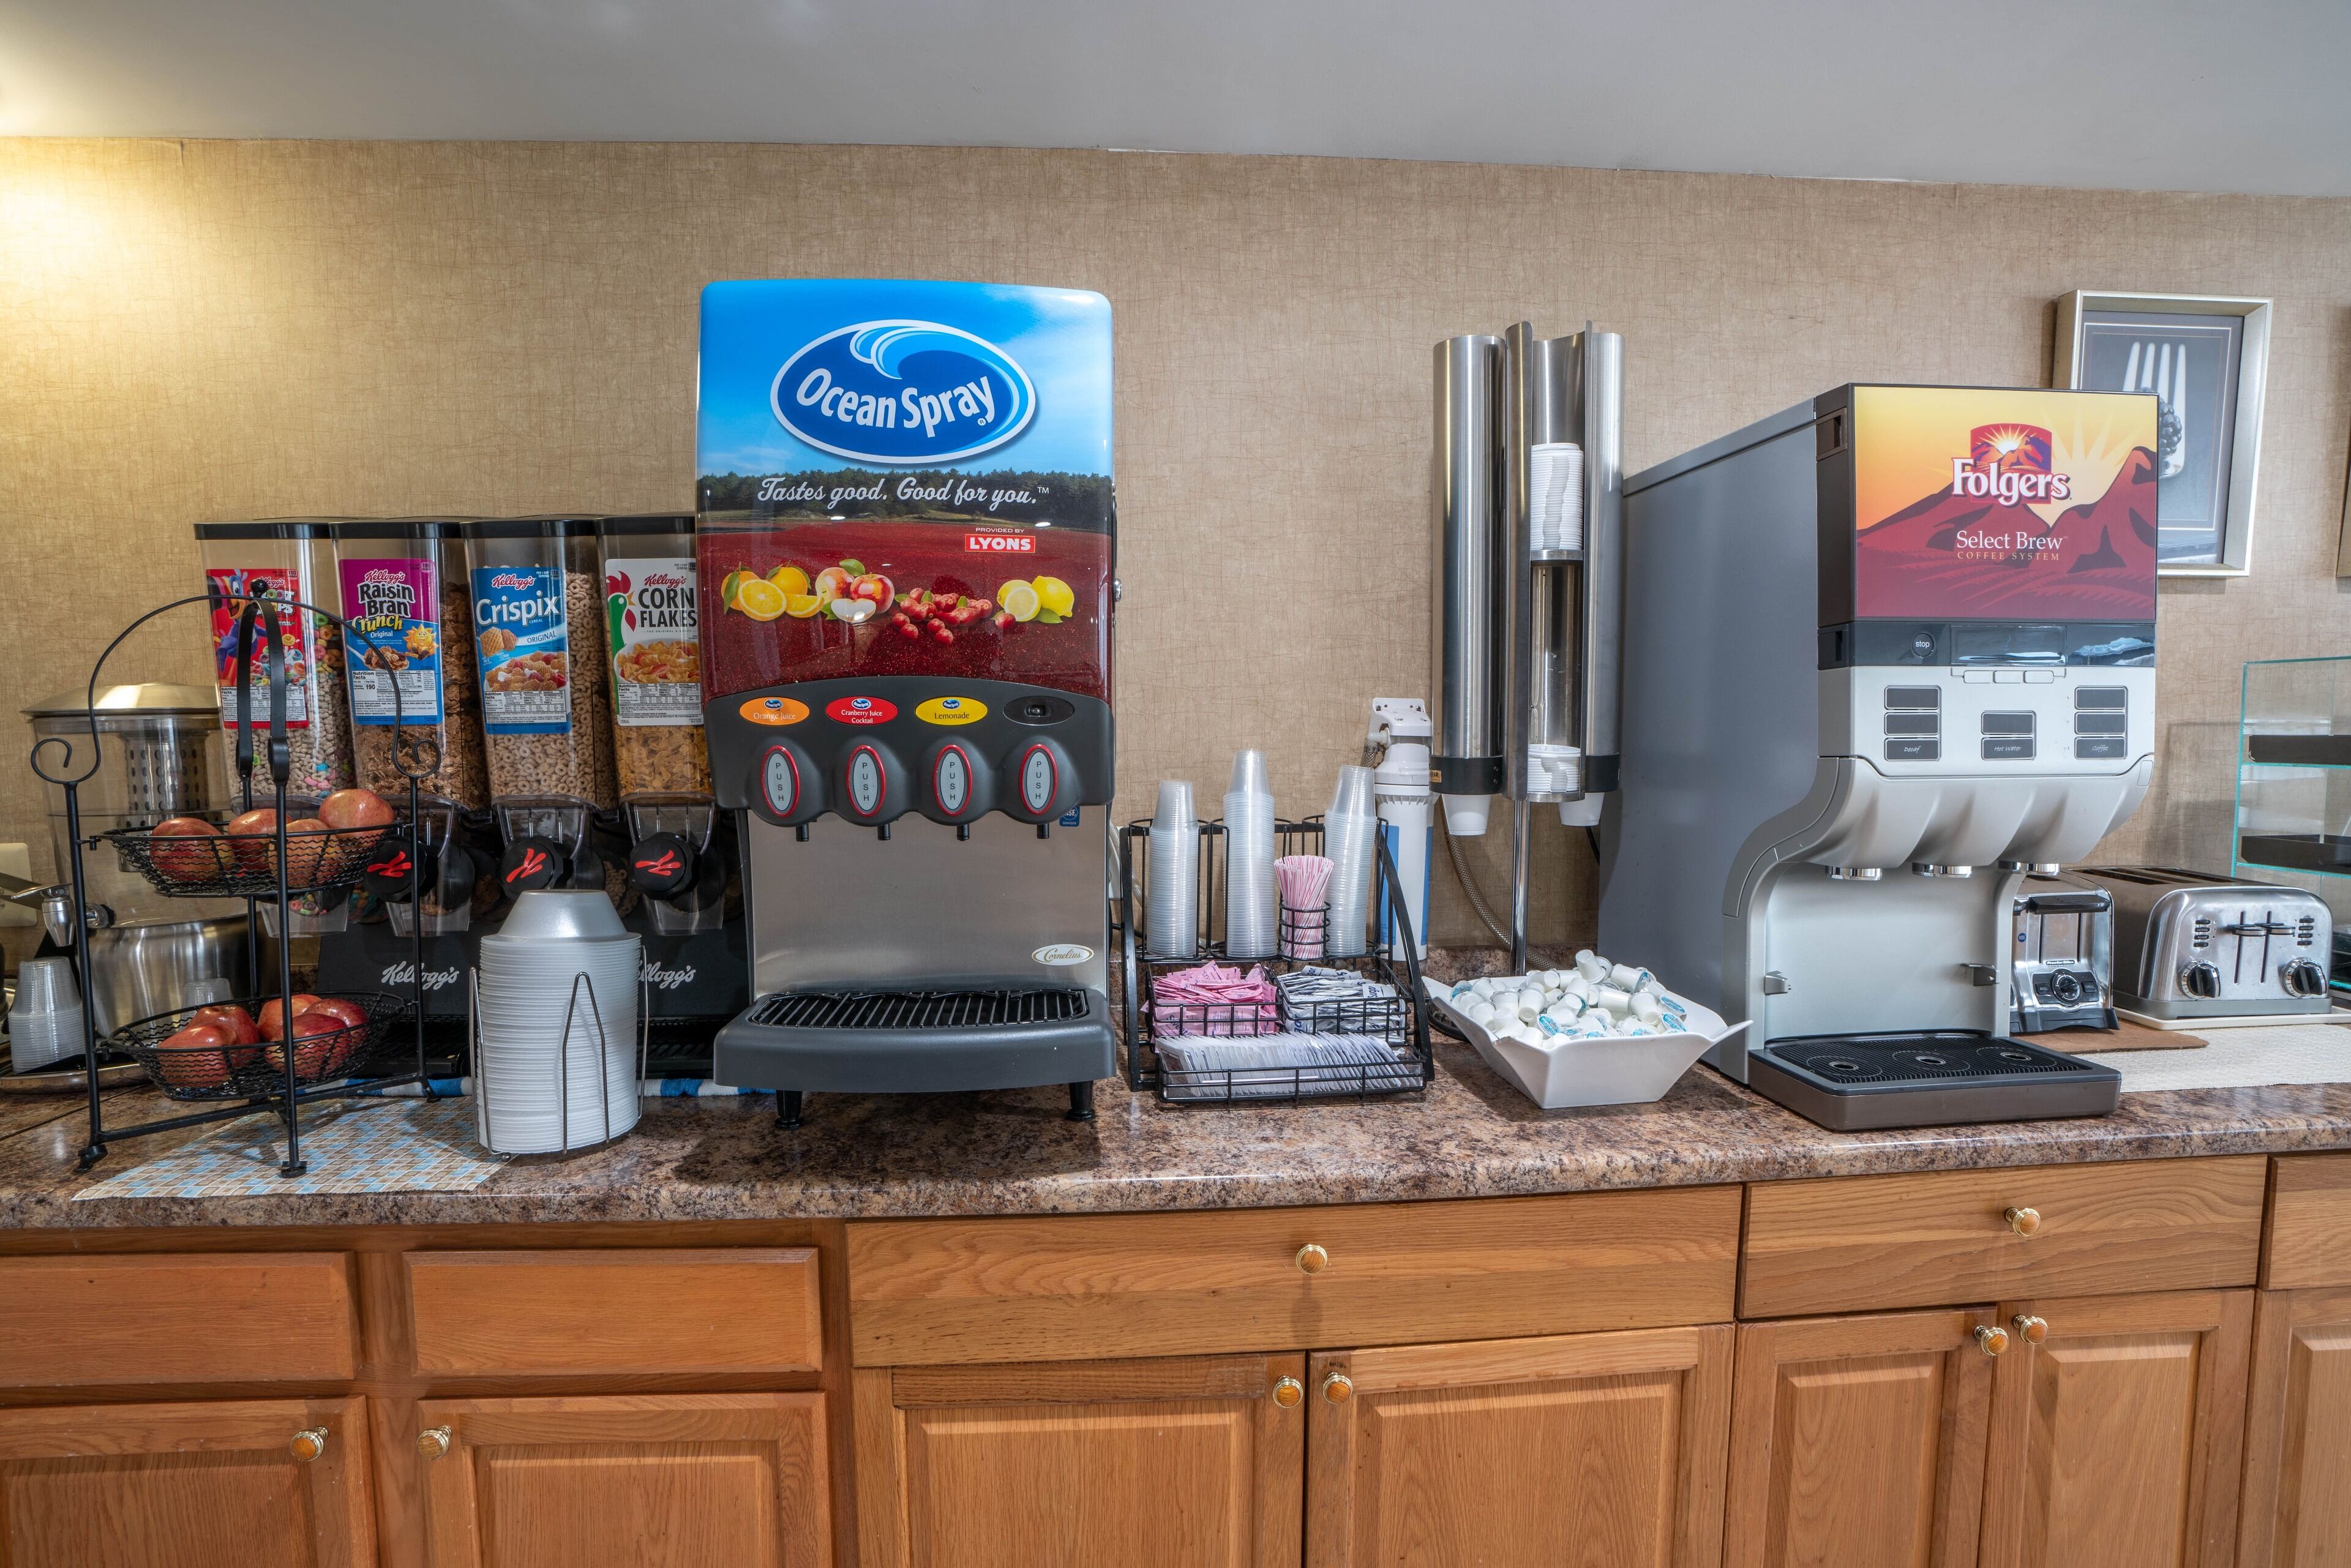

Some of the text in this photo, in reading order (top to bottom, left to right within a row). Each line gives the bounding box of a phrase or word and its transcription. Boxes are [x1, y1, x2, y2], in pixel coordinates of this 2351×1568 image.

[796, 367, 996, 438] Ocean Spray
[1952, 457, 2071, 508] Folgers
[757, 478, 825, 501] Tastes
[827, 479, 888, 509] good.
[897, 476, 953, 501] Good
[954, 479, 988, 506] for
[991, 489, 1037, 511] you.
[970, 537, 1031, 550] LYONS
[1957, 530, 2063, 550] Select Brew
[364, 569, 406, 584] Kellogg's
[492, 573, 534, 590] Kellogg's
[644, 573, 687, 588] Kellogg's
[359, 583, 415, 603] Raisin
[638, 588, 695, 609] CORN
[367, 599, 411, 618] Bran
[476, 590, 561, 627] Crispix
[640, 610, 697, 628] FLAKES
[527, 630, 557, 643] ORIGINAL
[1915, 640, 1930, 648] stop
[753, 712, 779, 722] Orange
[2092, 745, 2109, 753] Coffee
[775, 762, 784, 801] PUSH
[1043, 948, 1081, 962] Cornelius
